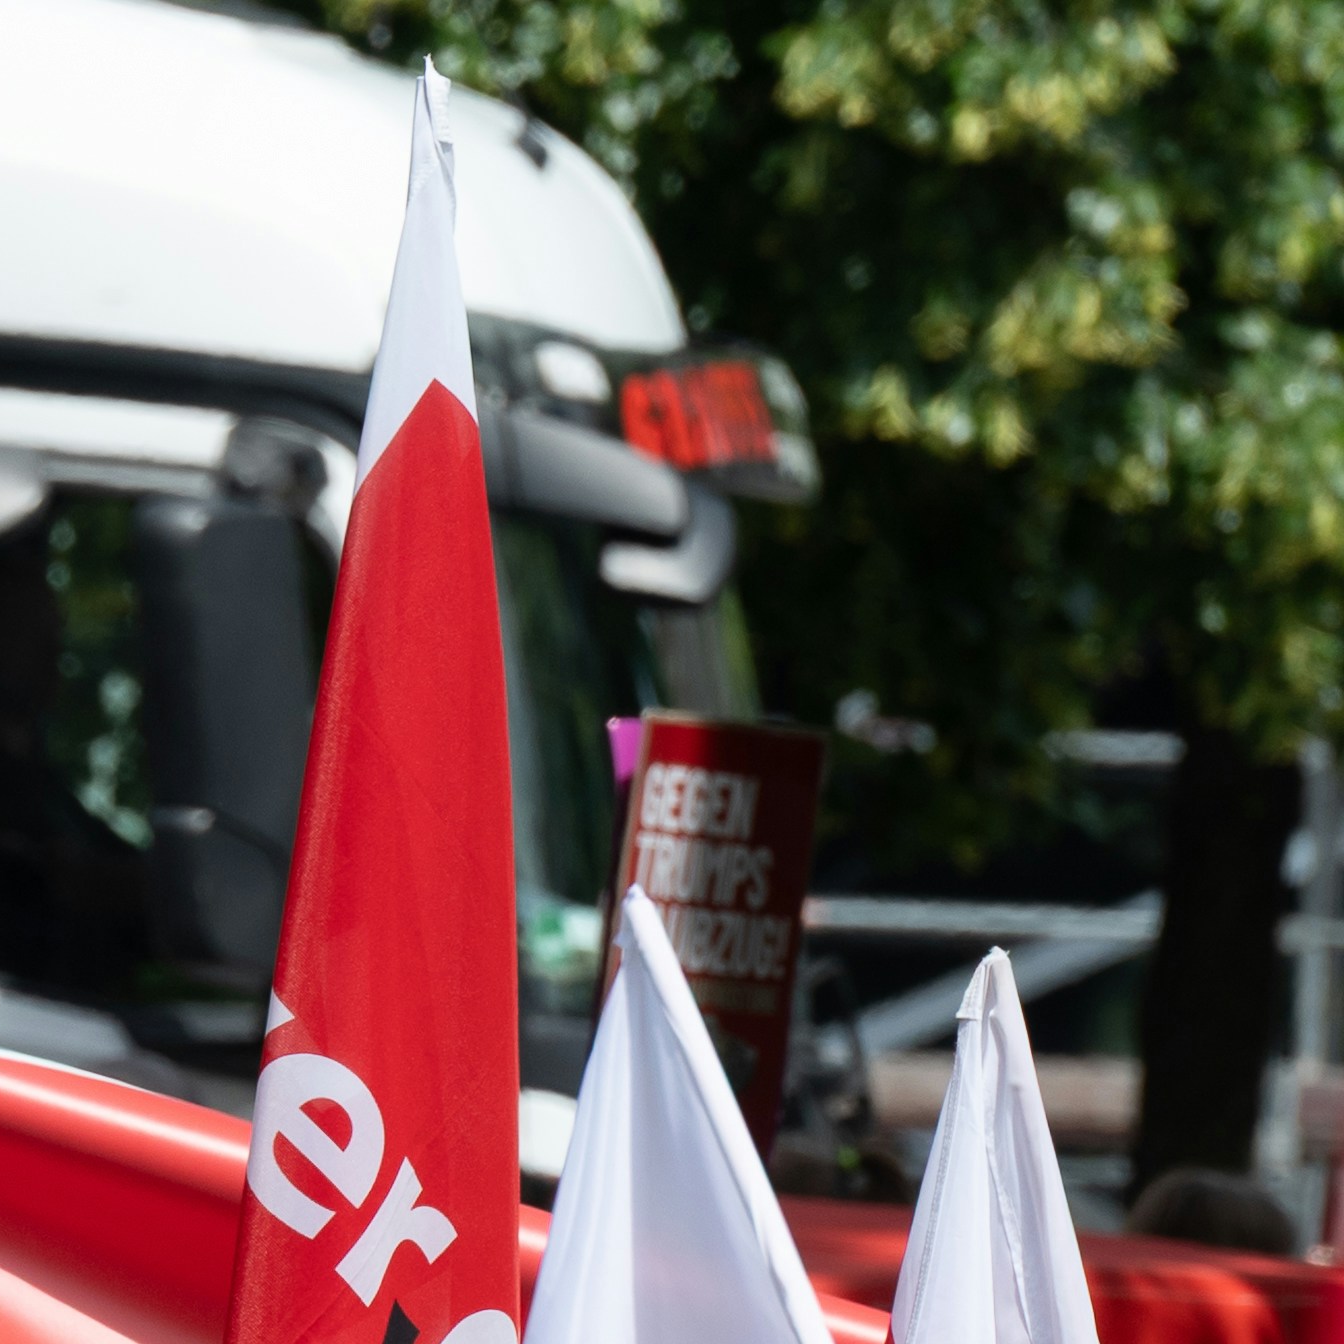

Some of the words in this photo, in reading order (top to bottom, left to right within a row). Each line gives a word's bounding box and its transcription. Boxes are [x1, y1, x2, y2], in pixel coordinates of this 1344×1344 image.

[640, 761, 759, 838] GEGEN
[635, 830, 774, 909] TRUMPS
[654, 902, 791, 980] UBZUG!
